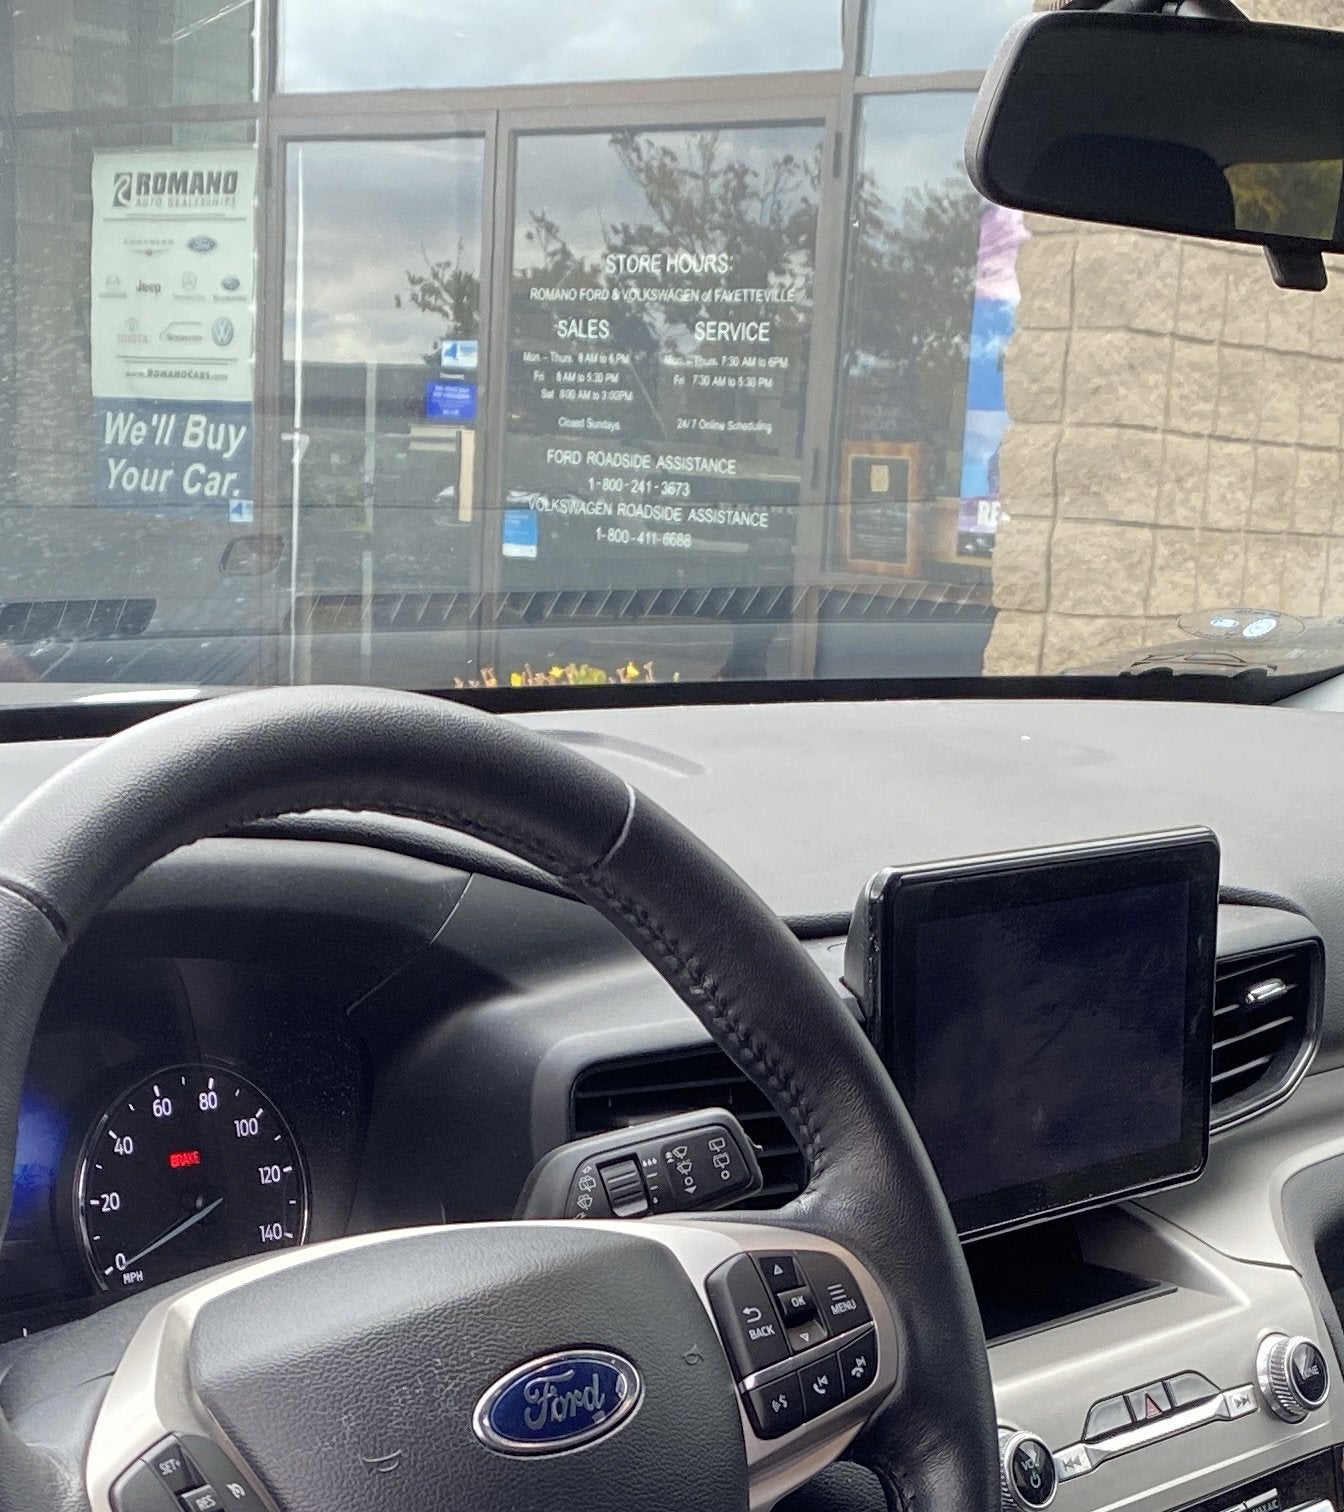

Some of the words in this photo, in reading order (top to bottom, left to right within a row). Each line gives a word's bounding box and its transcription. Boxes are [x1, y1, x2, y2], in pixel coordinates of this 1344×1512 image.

[136, 170, 238, 196] ROMANO
[605, 253, 662, 274] STORE
[666, 252, 734, 274] HOURS:
[135, 279, 162, 295] Jeep
[529, 287, 577, 301] ROMANO
[579, 287, 610, 301] FORD
[611, 287, 620, 301] &
[622, 287, 699, 302] VOLKSWAGEN
[714, 288, 796, 302] FAYETTEVILLE
[557, 318, 610, 339] SALES
[694, 321, 770, 341] SERVICE
[585, 352, 598, 364] AM
[741, 356, 756, 368] AM
[563, 371, 576, 383] AM
[605, 373, 619, 383] PM
[712, 376, 727, 387] AM
[758, 377, 773, 388] PM
[558, 416, 585, 428] Closed
[586, 417, 620, 432] Sundays
[104, 411, 176, 446] We'll
[182, 413, 247, 459] Buy
[546, 448, 582, 465] FORD
[586, 450, 651, 469] ROADSIDE
[655, 455, 737, 475] ASSISTANCE
[108, 457, 174, 493] Your
[181, 462, 240, 497] Car.
[528, 494, 613, 516] VOLKSWAGEN
[616, 503, 682, 522] ROADSIDE
[687, 508, 769, 528] ASSISTANCE
[152, 1098, 172, 1117] 60
[199, 1091, 218, 1110] 80
[233, 1117, 258, 1138] 100
[113, 1136, 133, 1155] 40
[169, 1150, 201, 1168] BRAKE
[258, 1164, 281, 1185] 120
[100, 1192, 120, 1212] 20
[259, 1222, 283, 1242] 140
[115, 1252, 127, 1271] 0
[122, 1270, 144, 1285] MPH
[791, 1295, 806, 1308] OK
[830, 1299, 857, 1315] MENU
[748, 1324, 776, 1340] BACK
[523, 1368, 606, 1431] Ford
[195, 1494, 216, 1511] RES
